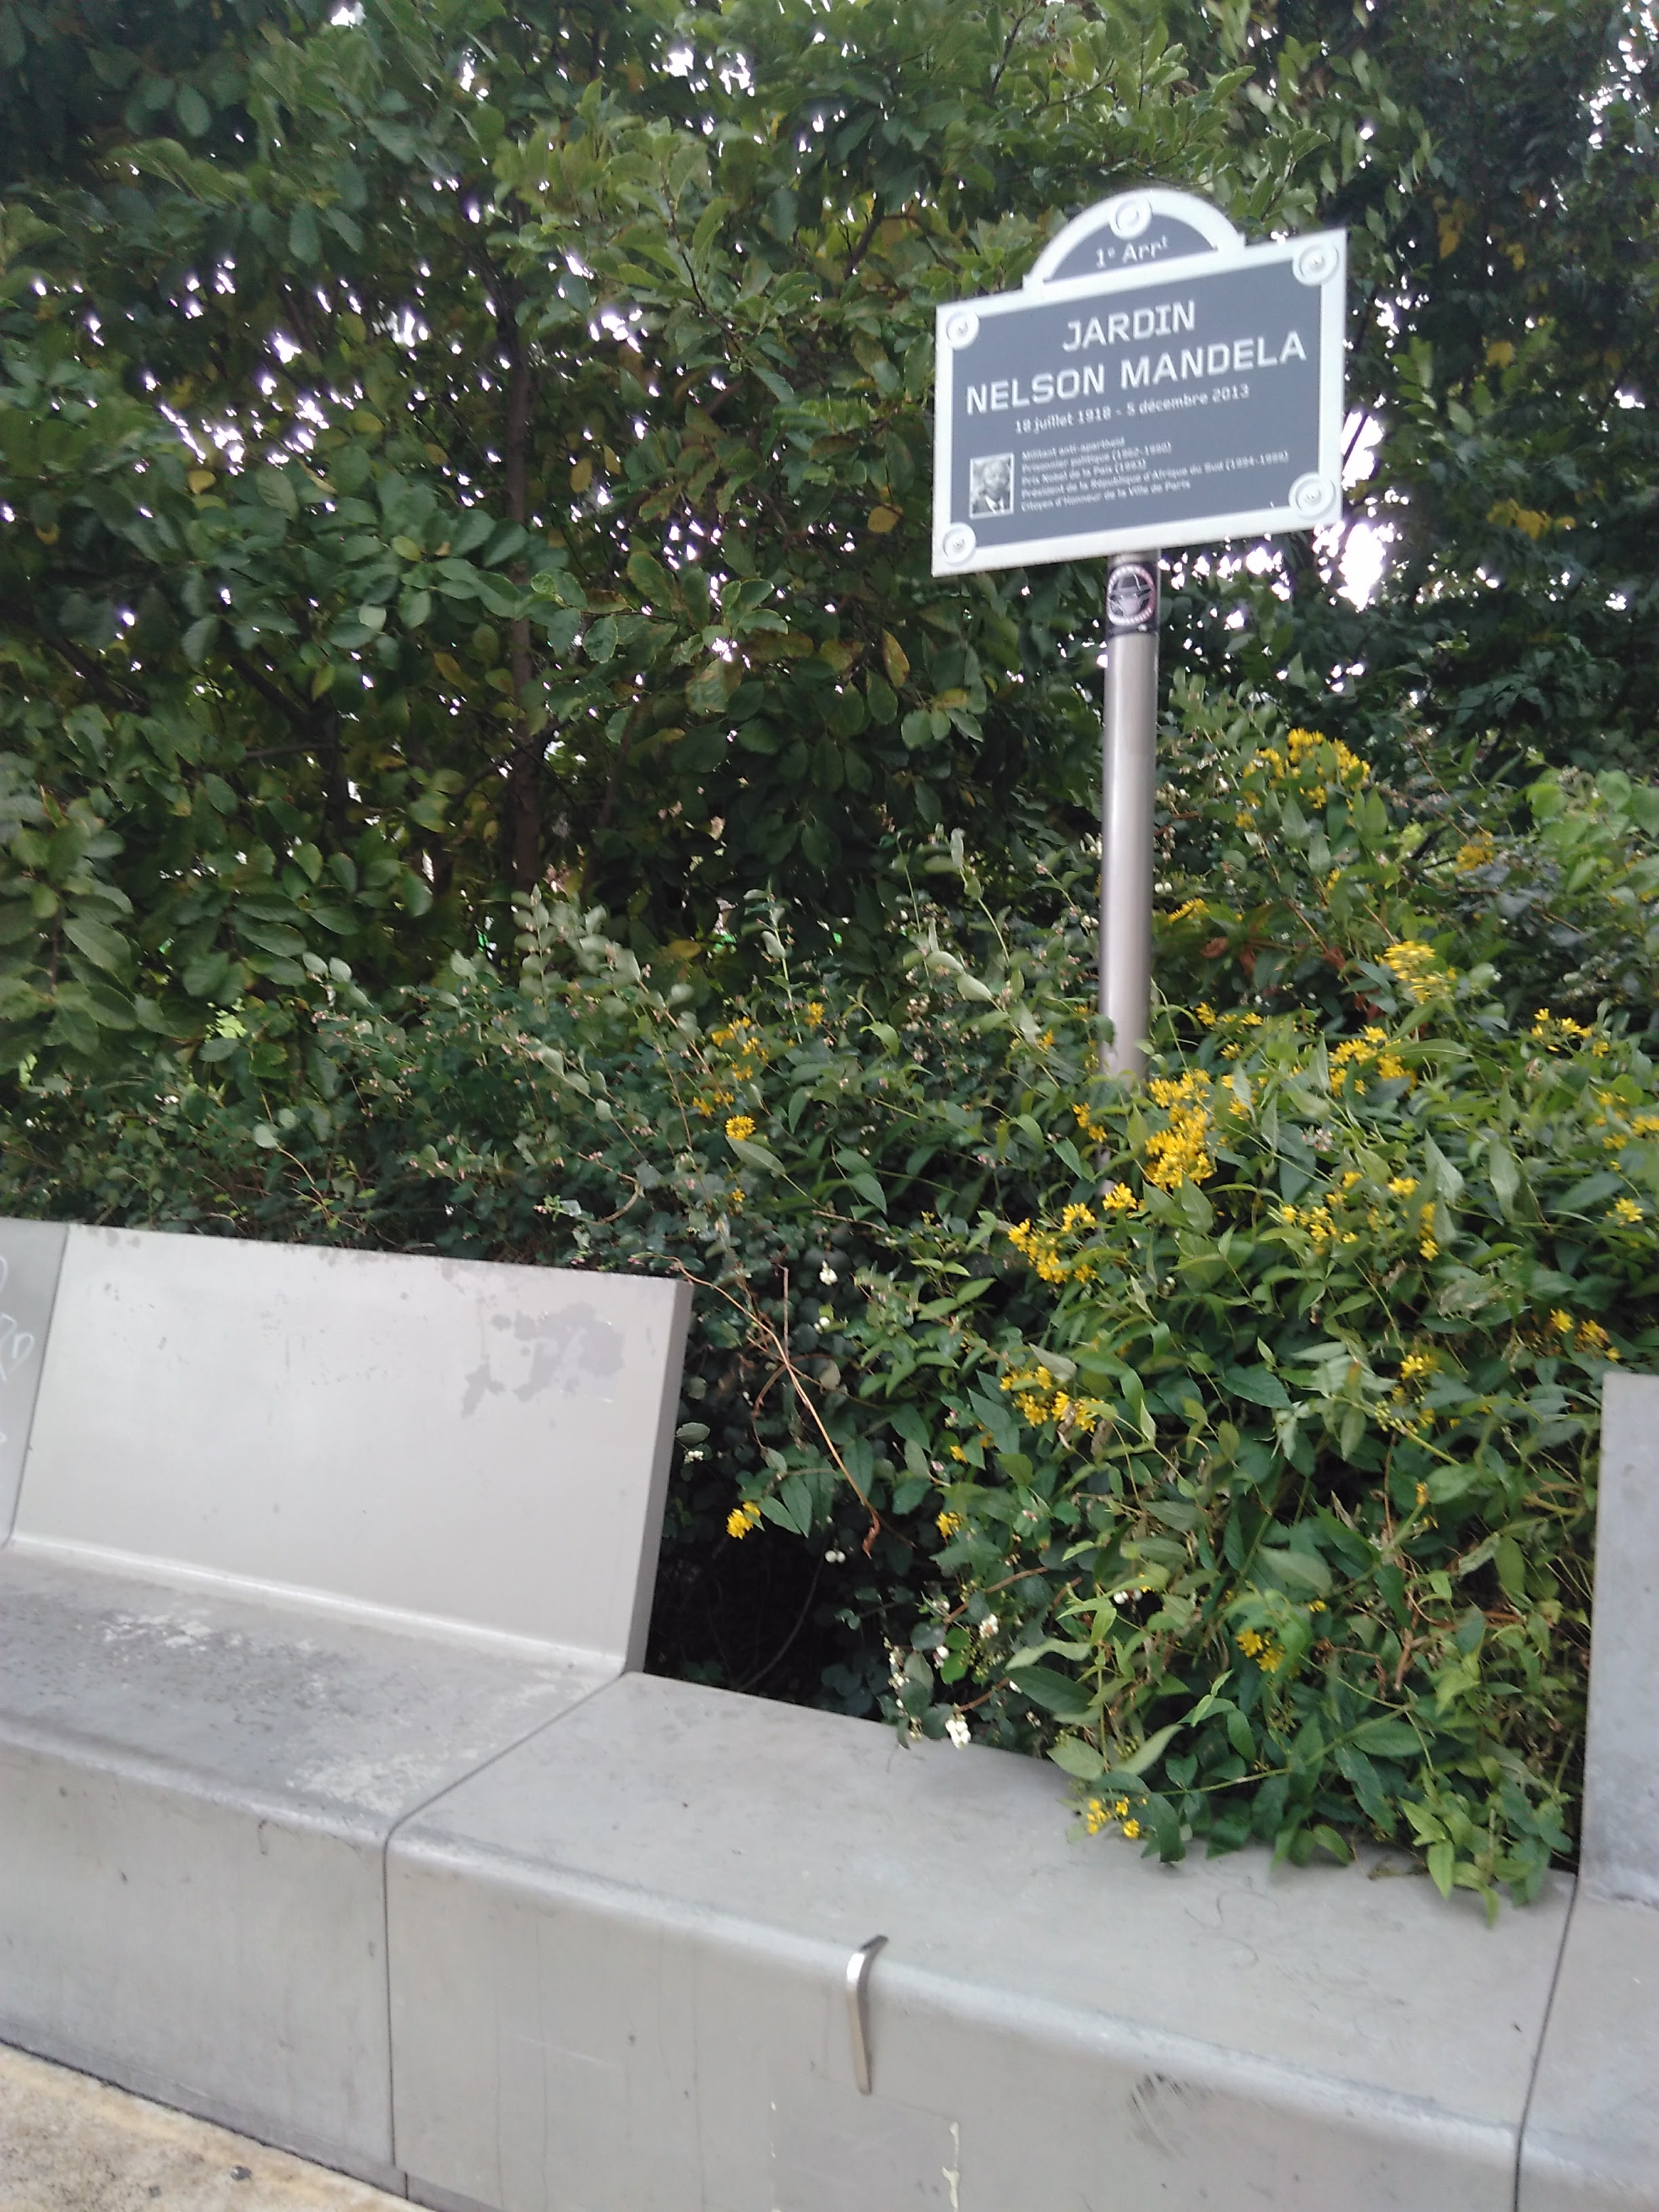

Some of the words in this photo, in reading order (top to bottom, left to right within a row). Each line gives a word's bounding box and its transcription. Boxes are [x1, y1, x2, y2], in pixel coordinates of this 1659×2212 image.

[1062, 300, 1195, 352] JARDIN
[967, 364, 1105, 415] NELSON
[1121, 330, 1307, 390] MANDELA
[1015, 419, 1031, 434] 18
[1033, 412, 1073, 434] juillet
[1077, 405, 1111, 426] 1918
[1126, 401, 1136, 417] 5
[1139, 392, 1208, 415] décembre
[1212, 383, 1250, 403] 2013
